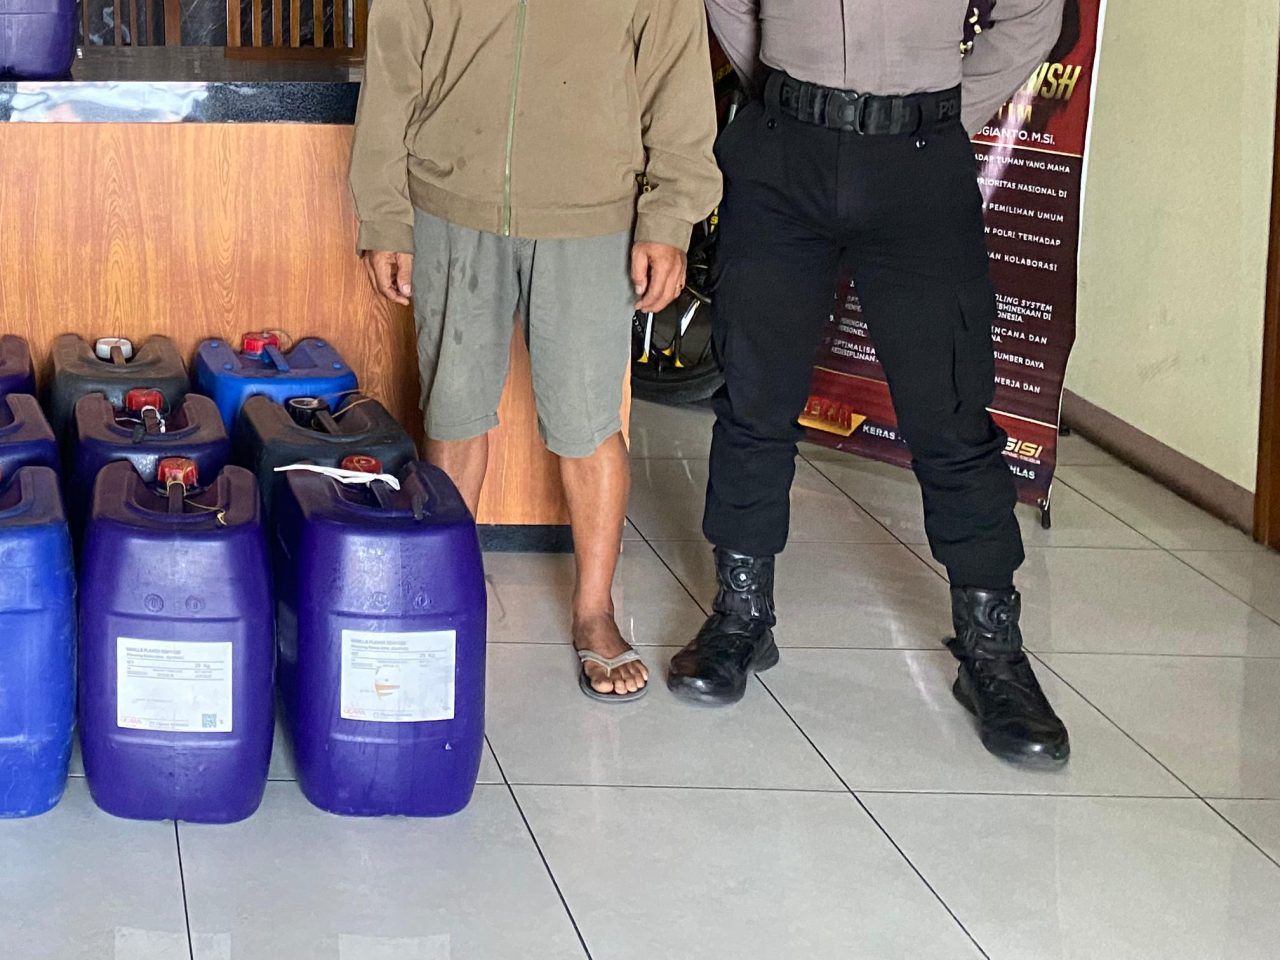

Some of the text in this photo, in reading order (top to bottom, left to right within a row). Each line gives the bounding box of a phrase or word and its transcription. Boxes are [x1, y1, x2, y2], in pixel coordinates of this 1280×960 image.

[1047, 163, 1070, 173] MAHA
[1018, 184, 1057, 196] NASIONAL
[989, 203, 1064, 222] PEMILIHAN UMUM
[993, 228, 1016, 239] POLRI
[1018, 232, 1061, 246] TERHADAP
[1004, 254, 1058, 271] KOLABORASI
[1021, 300, 1053, 312] SYSTEM
[1028, 334, 1048, 345] DAN
[993, 351, 1045, 370] SUMBER DAYA
[1023, 383, 1041, 394] DAN
[862, 425, 896, 440] KERAS
